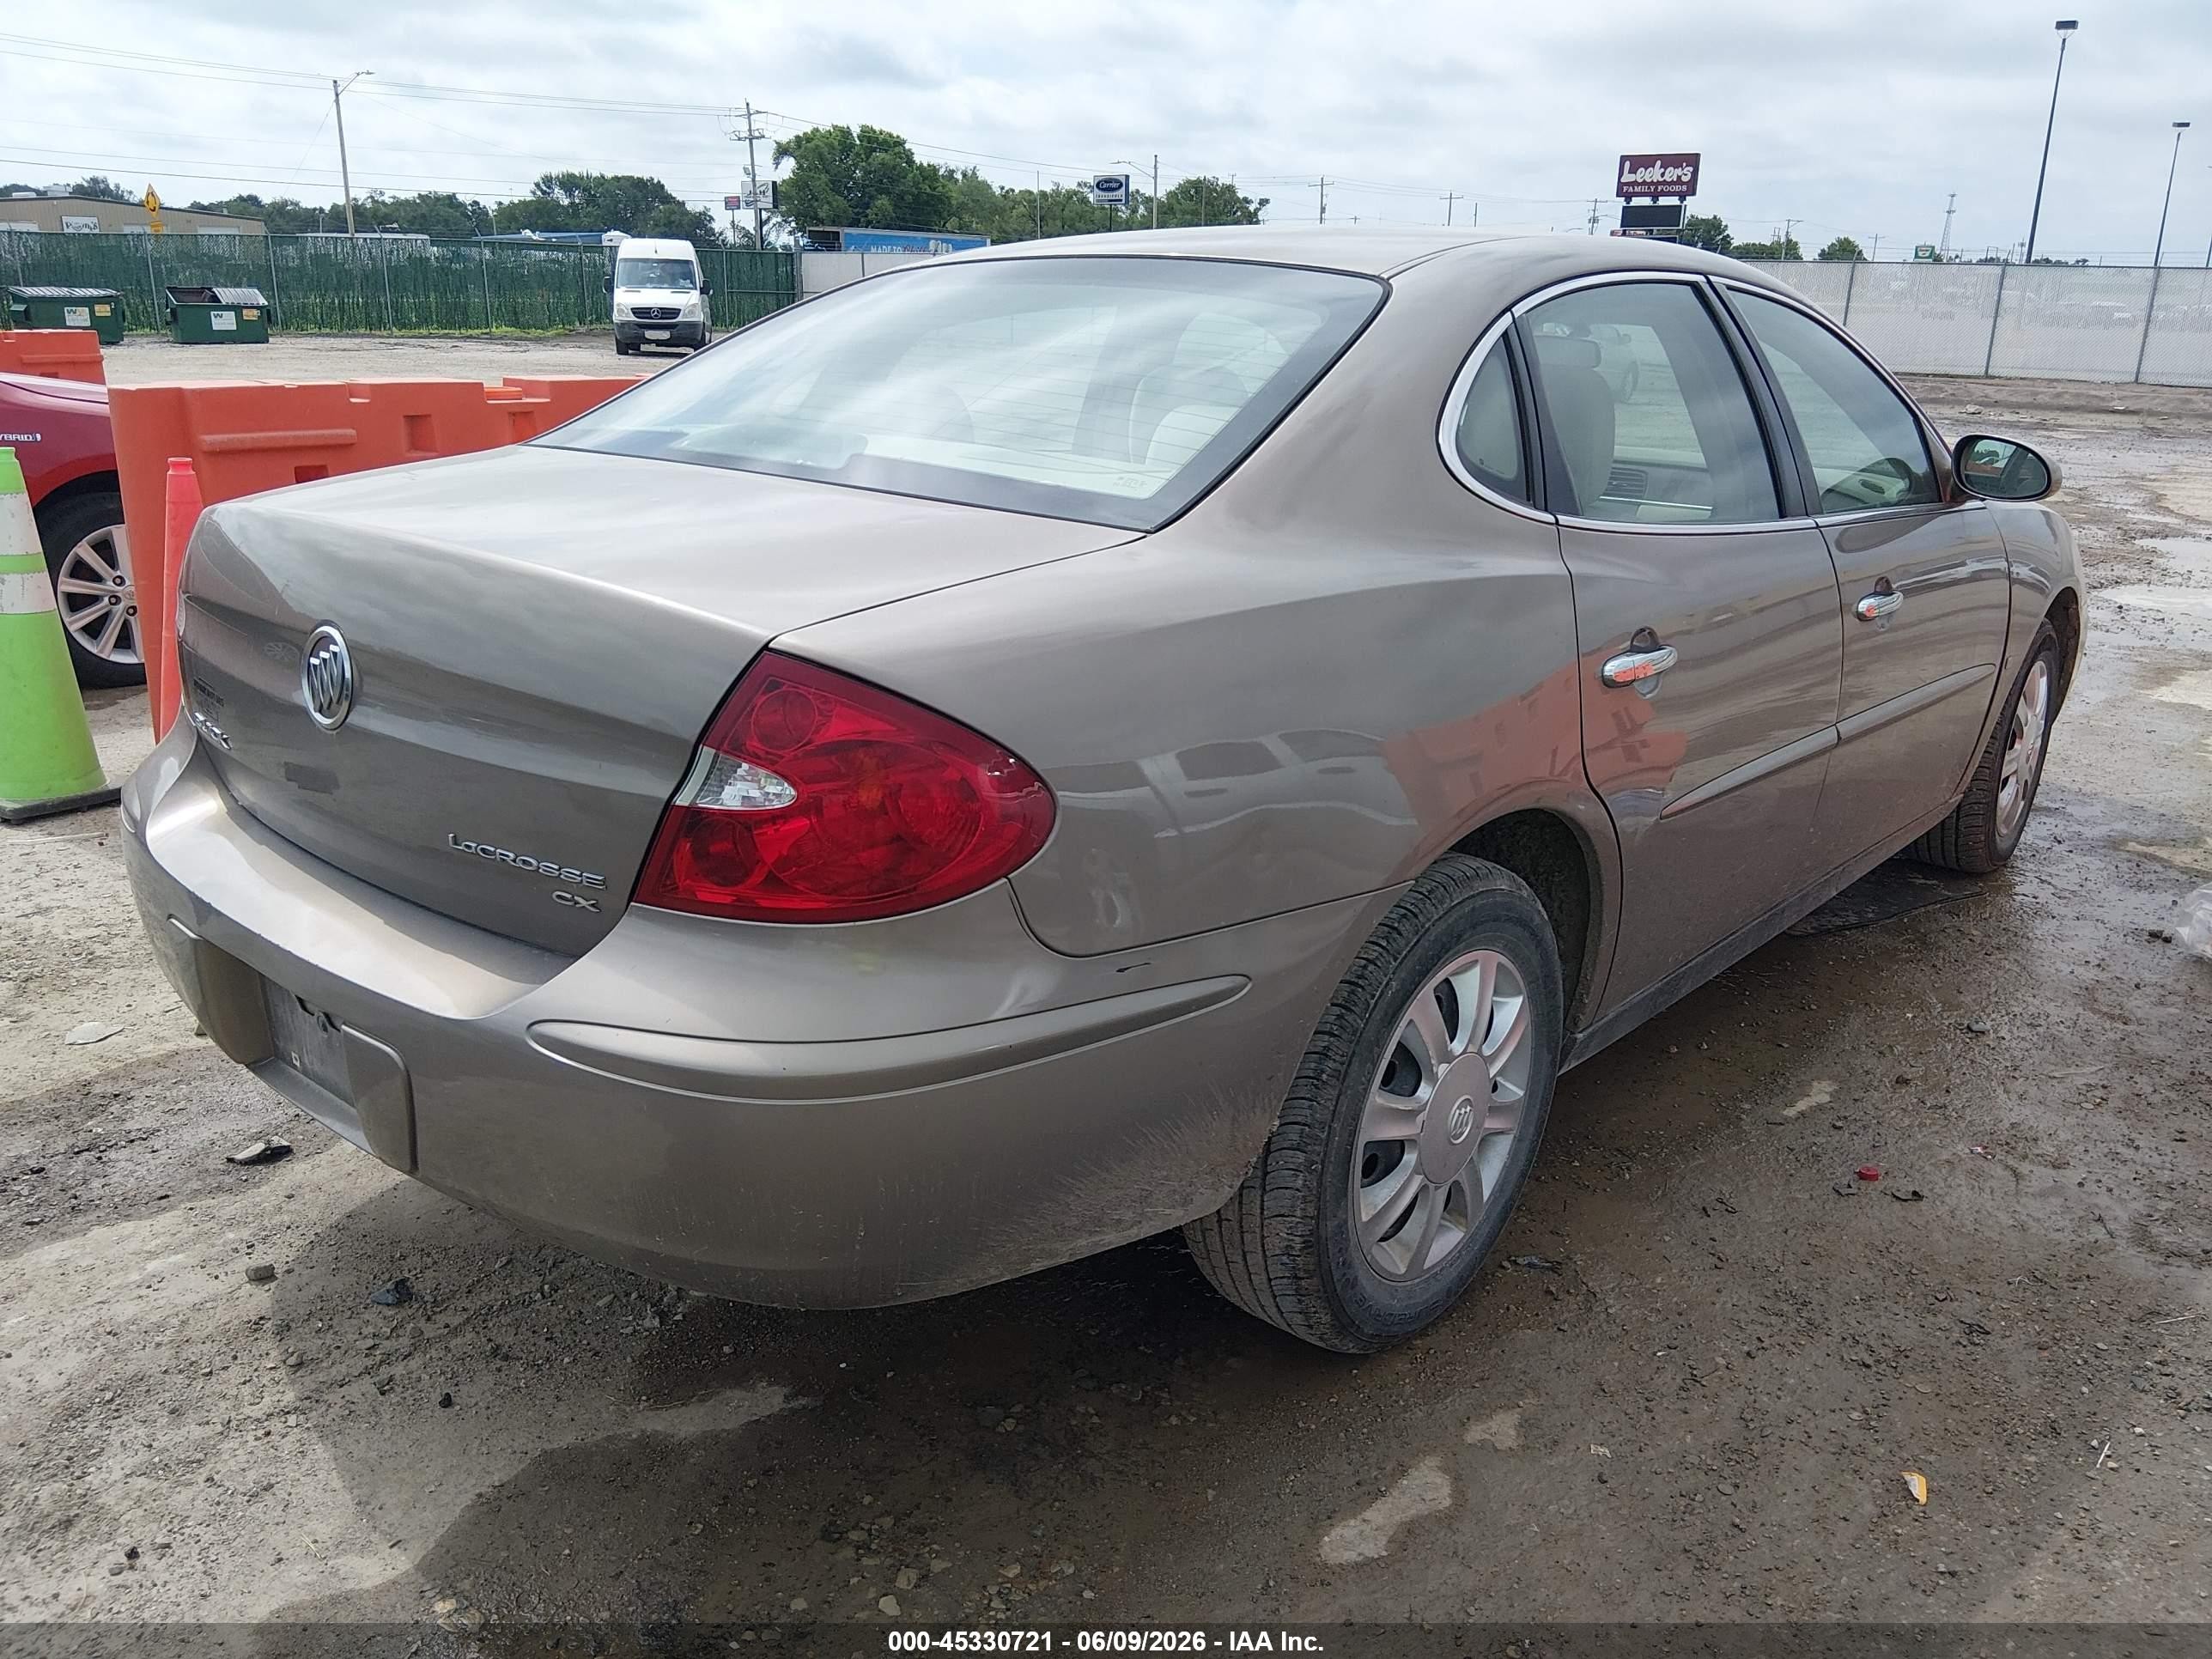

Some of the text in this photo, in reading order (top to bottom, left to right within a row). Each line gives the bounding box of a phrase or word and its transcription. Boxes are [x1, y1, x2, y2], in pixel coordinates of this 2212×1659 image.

[1620, 160, 1693, 183] Leeker's
[1099, 180, 1121, 189] Carrier
[871, 245, 891, 253] MADE
[552, 890, 601, 913] CX
